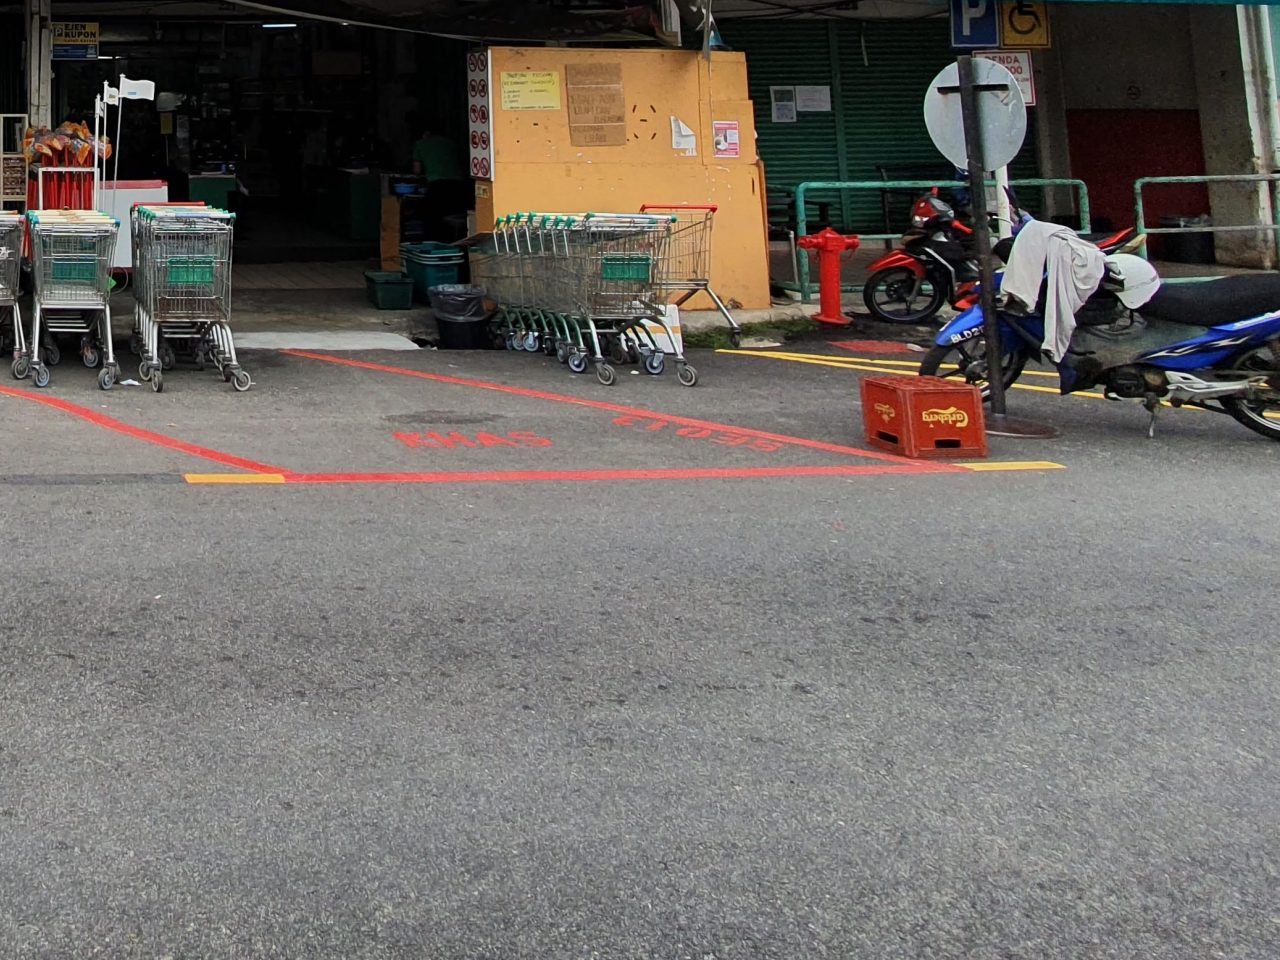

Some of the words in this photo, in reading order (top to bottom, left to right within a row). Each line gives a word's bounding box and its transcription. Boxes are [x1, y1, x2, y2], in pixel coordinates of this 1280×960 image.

[64, 31, 97, 39] KUPON
[922, 406, 968, 428] Carlsberg
[392, 430, 554, 448] KHAS
